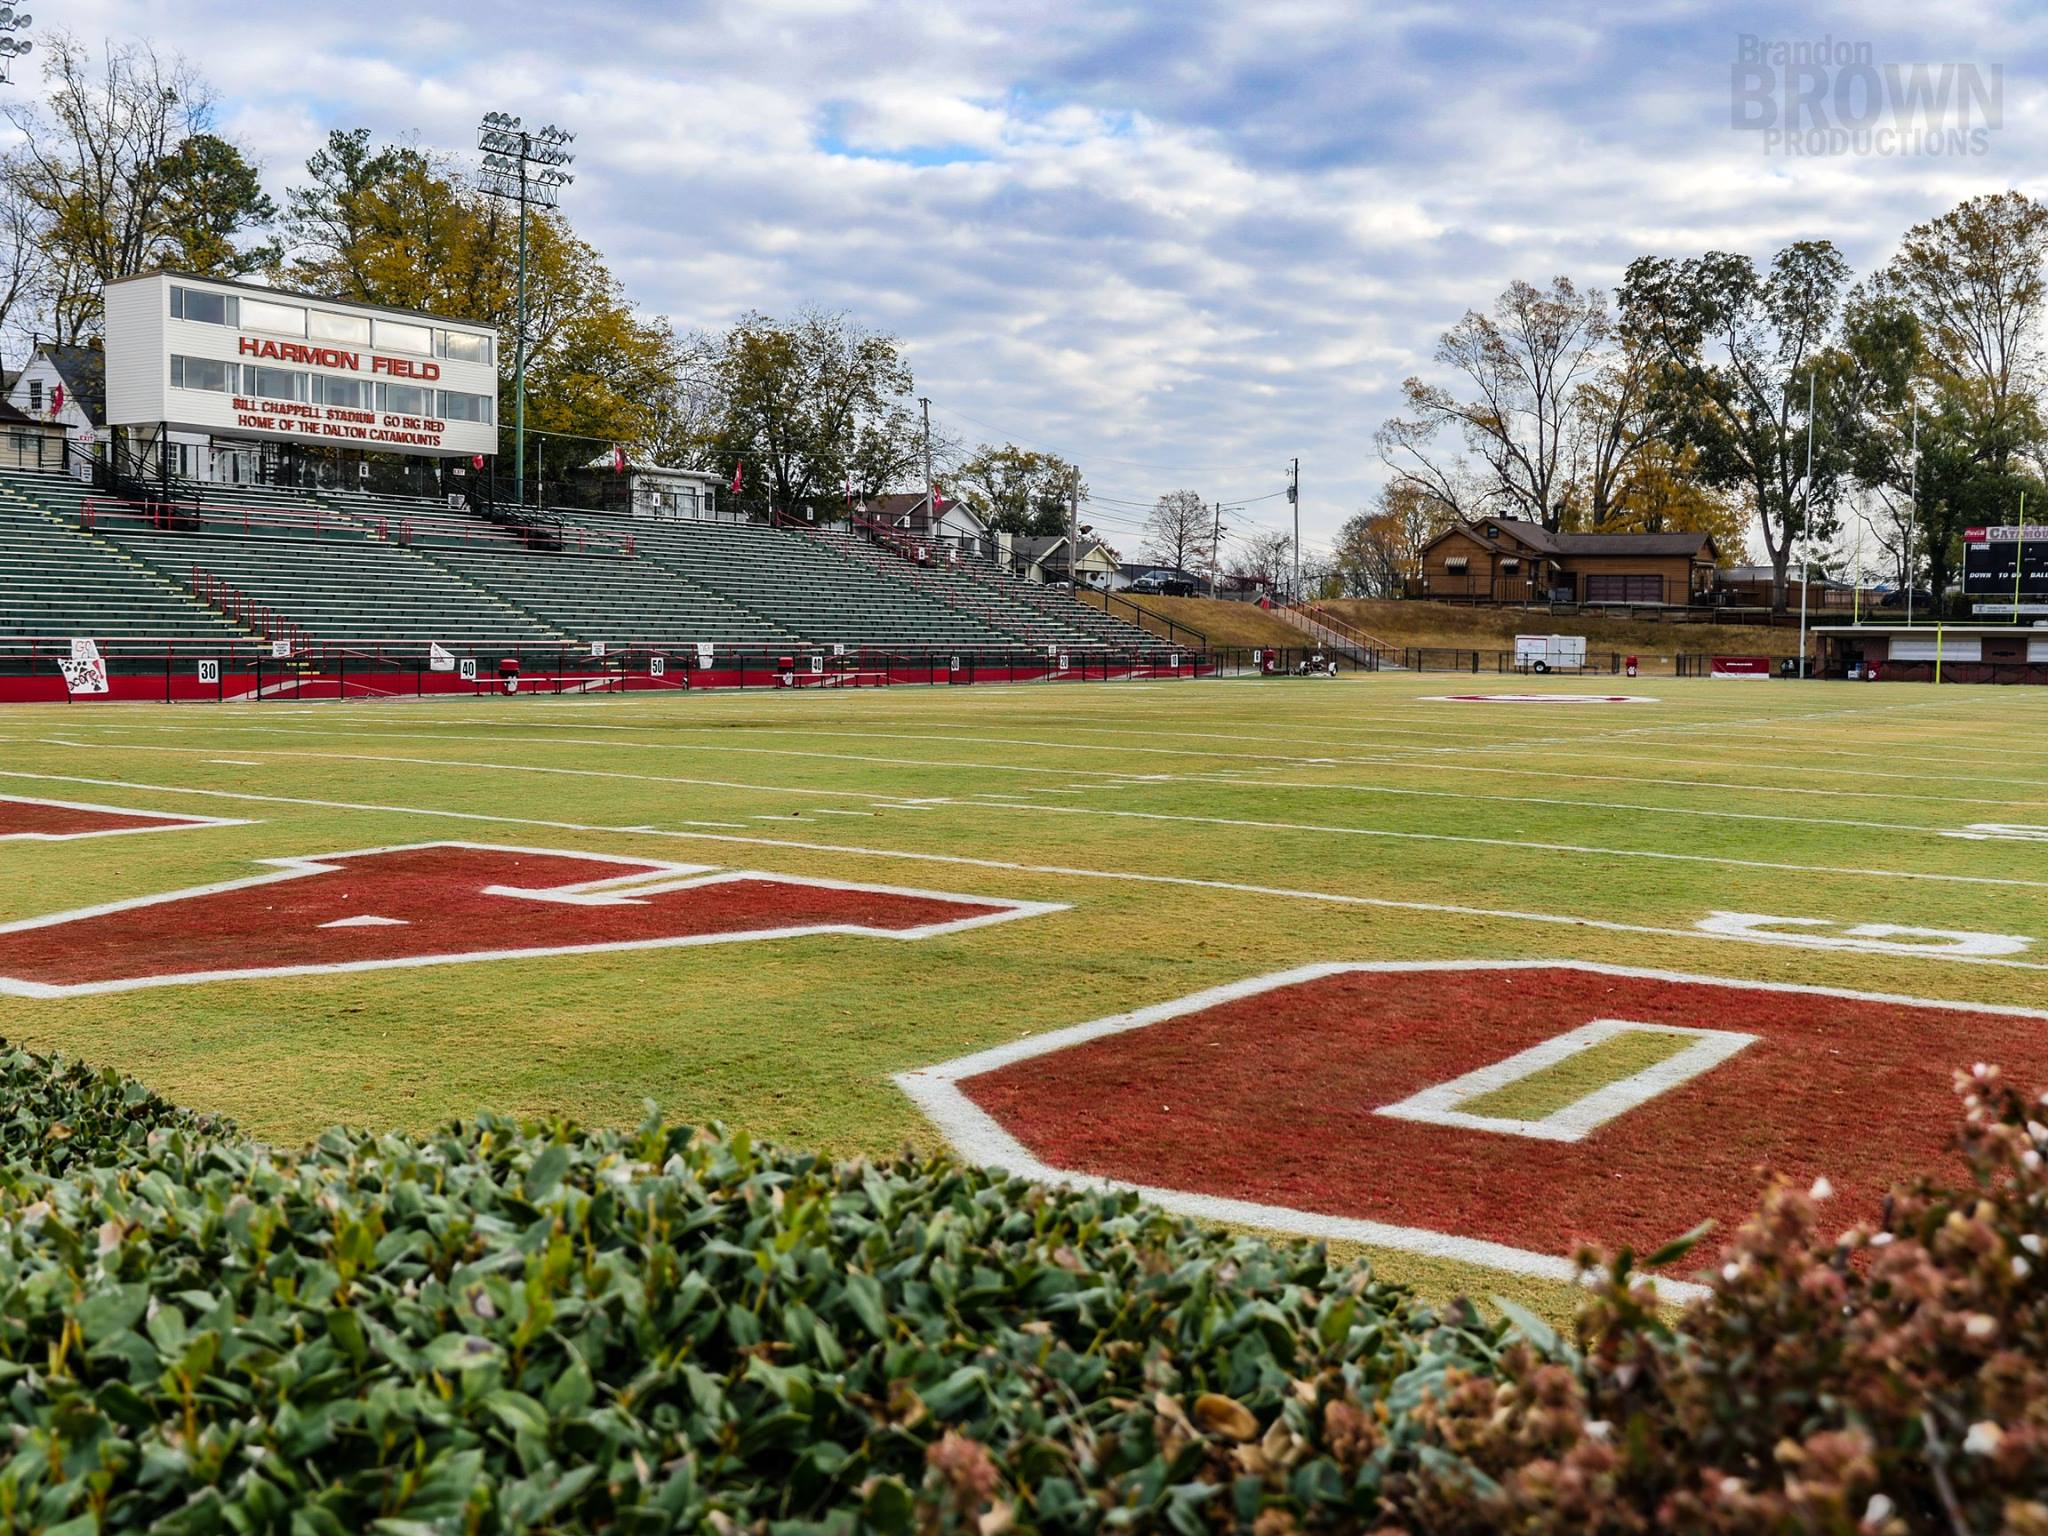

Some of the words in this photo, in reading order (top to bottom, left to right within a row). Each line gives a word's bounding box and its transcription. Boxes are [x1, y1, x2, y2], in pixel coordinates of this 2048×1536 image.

[239, 336, 359, 371] HARMON
[372, 355, 440, 381] FIELD
[232, 398, 258, 412] BILL
[262, 402, 322, 419] CHAPPELL
[327, 408, 375, 424] STADIUM
[383, 415, 401, 428] GO
[402, 417, 421, 430] BIG
[423, 419, 445, 433] RED
[238, 414, 275, 430] HOME
[279, 419, 295, 431] OF
[299, 421, 321, 434] THE
[323, 423, 367, 439] DALTON
[369, 428, 441, 446] CATAMOUNTS
[201, 663, 216, 680] 30
[463, 661, 474, 676] 40
[651, 659, 662, 674] 50
[813, 658, 821, 671] 40
